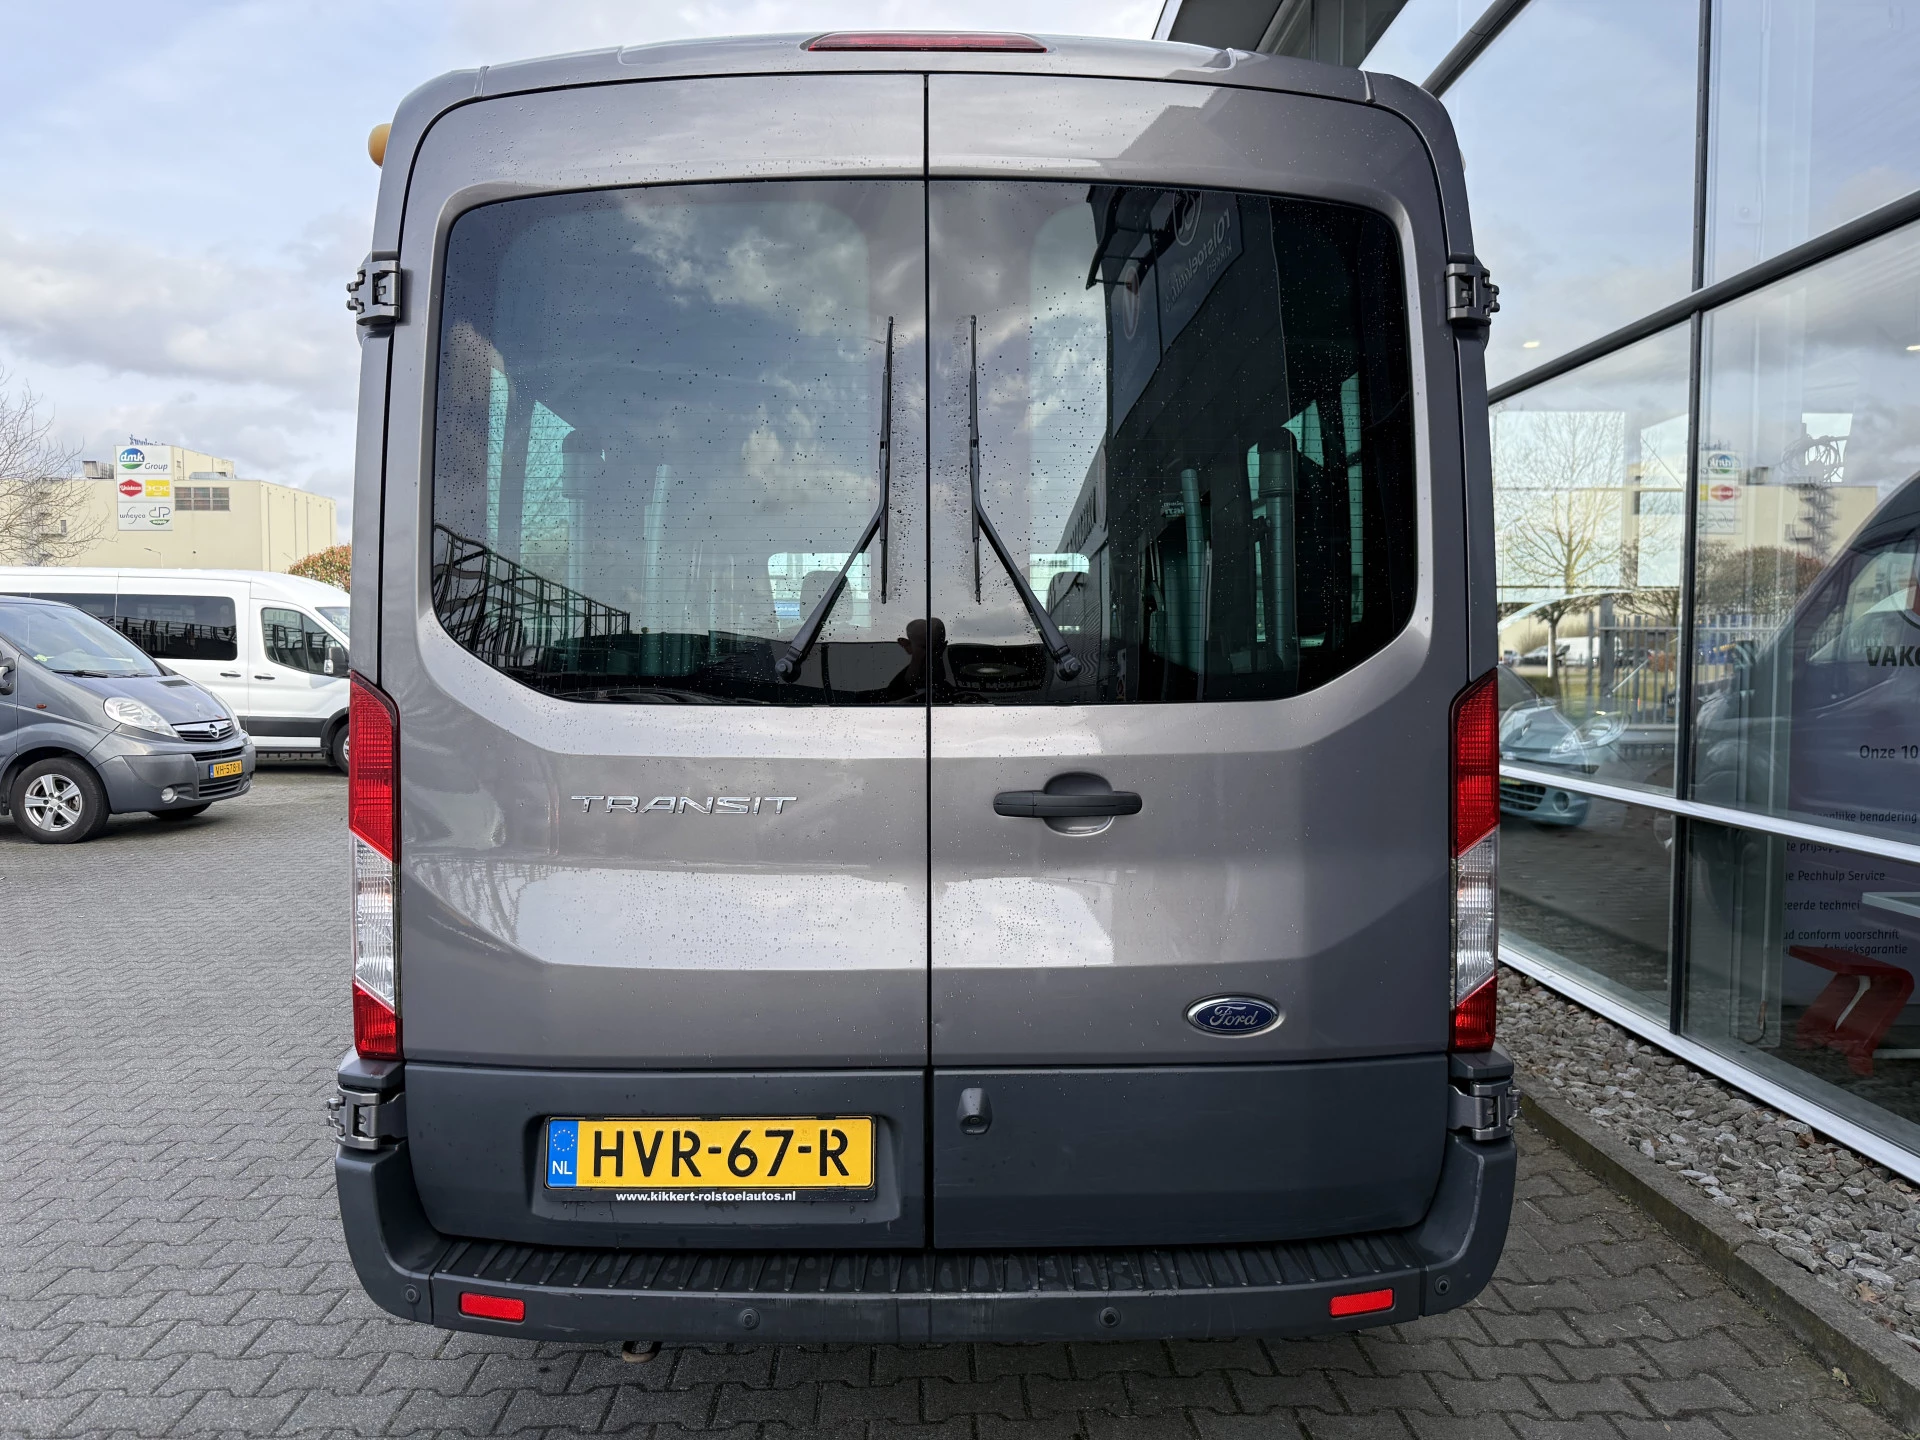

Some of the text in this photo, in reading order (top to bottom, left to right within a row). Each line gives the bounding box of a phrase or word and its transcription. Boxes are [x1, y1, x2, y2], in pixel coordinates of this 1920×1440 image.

[120, 452, 144, 462] dmk
[144, 462, 168, 472] Group
[1859, 744, 1919, 759] Onze 10
[571, 795, 797, 815] TRANSIT
[1859, 811, 1917, 824] benadering
[1798, 870, 1845, 883] Pechhulp
[1848, 870, 1885, 881] Service
[1798, 929, 1841, 940] conform
[1844, 929, 1900, 940] voorschrift
[1209, 1005, 1259, 1026] Ford
[593, 1129, 850, 1177] HVR-67-R
[552, 1160, 573, 1176] NL
[615, 1190, 796, 1202] www.kikkert-rolstoelautos.nl
